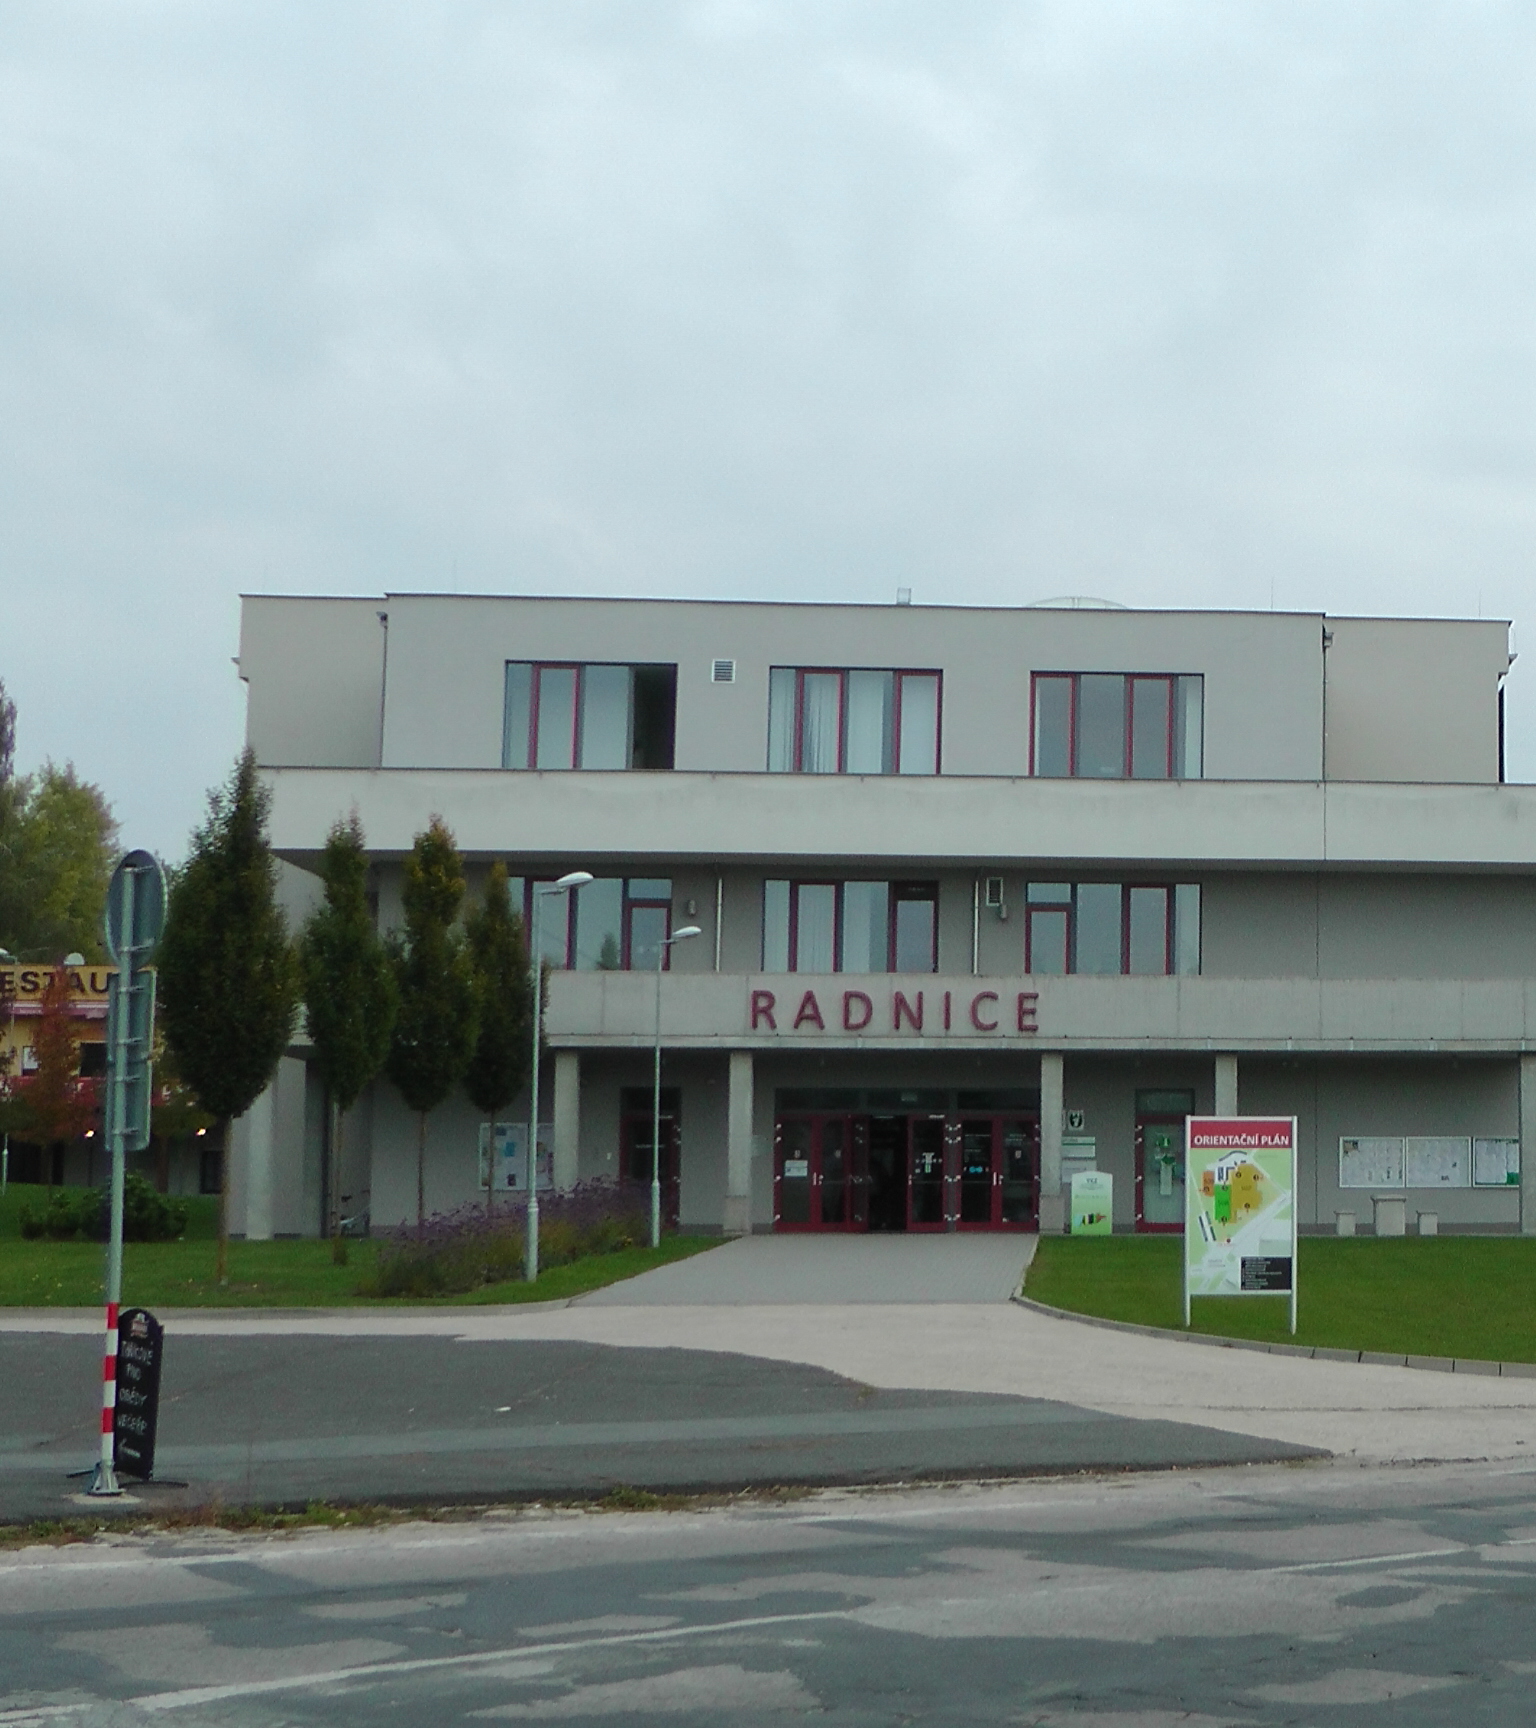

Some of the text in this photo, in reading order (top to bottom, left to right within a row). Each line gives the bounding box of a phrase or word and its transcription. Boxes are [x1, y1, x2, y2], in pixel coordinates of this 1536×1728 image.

[751, 989, 1039, 1032] RADNICE
[1194, 1133, 1289, 1146] ORIENTAČNÍ PLÁN
